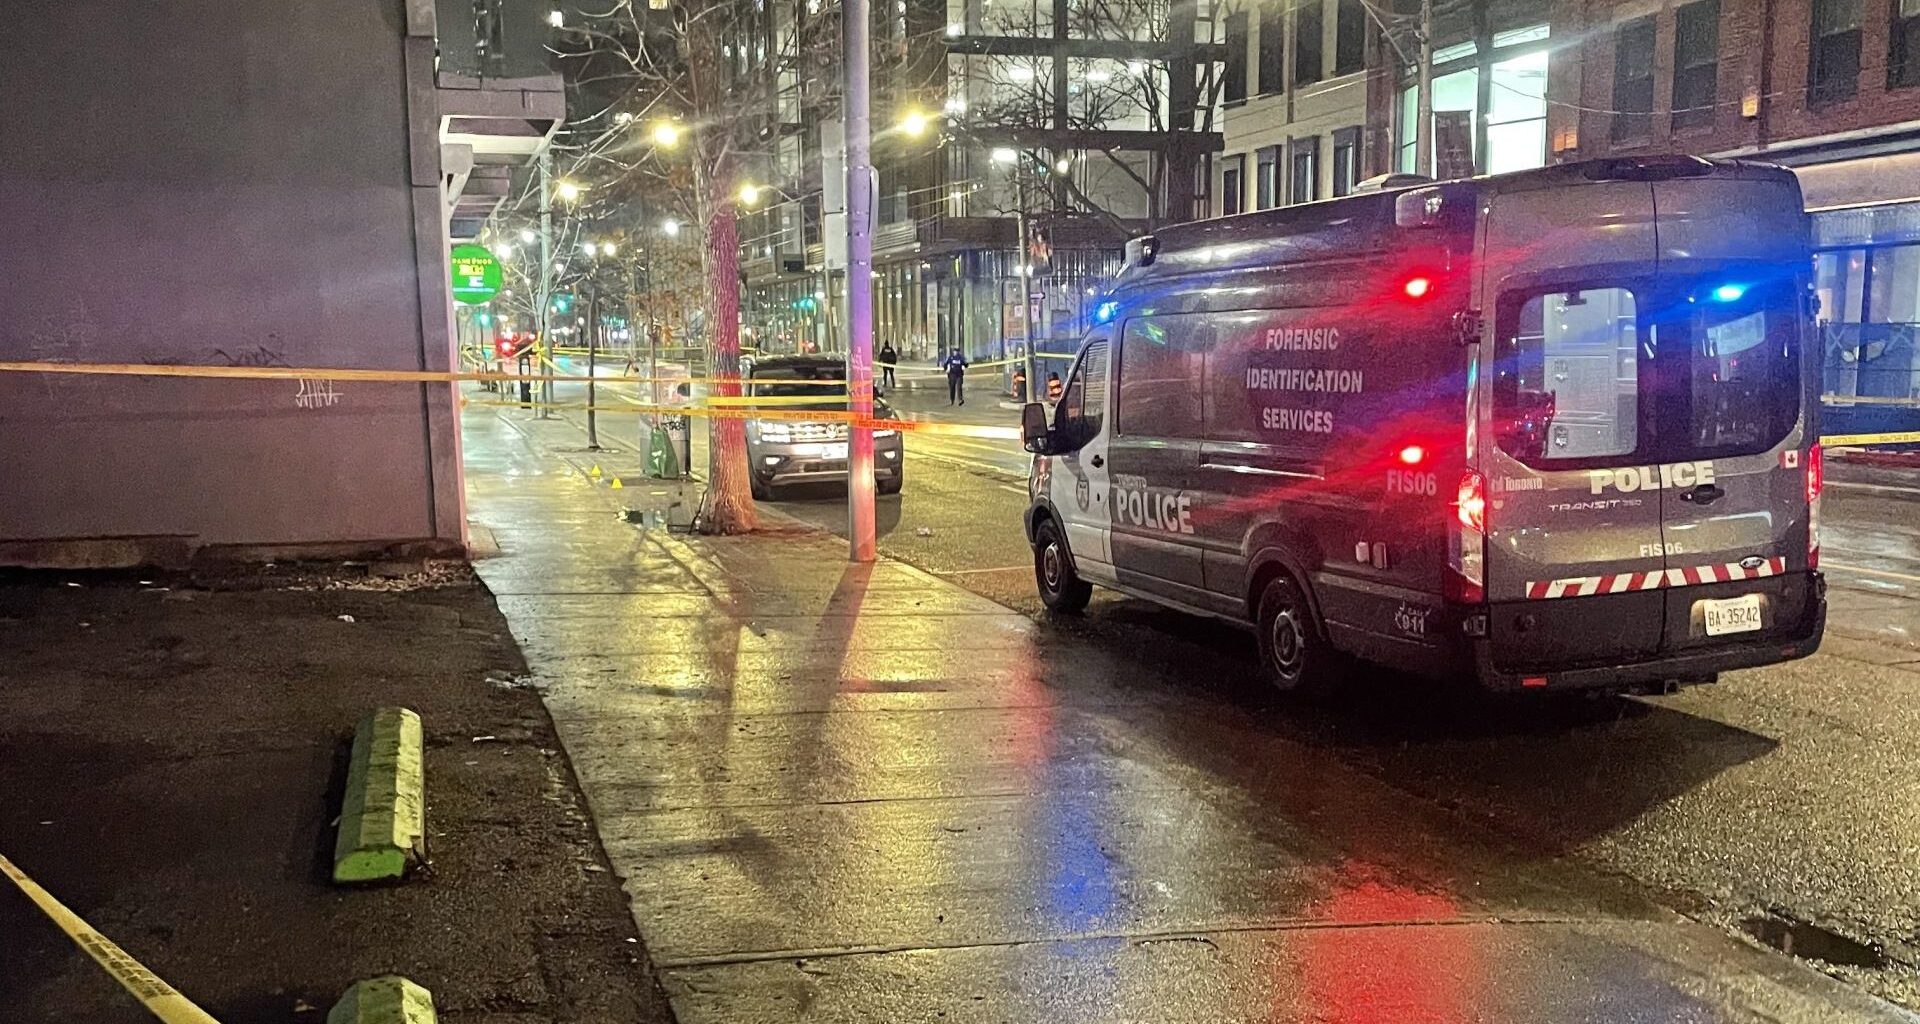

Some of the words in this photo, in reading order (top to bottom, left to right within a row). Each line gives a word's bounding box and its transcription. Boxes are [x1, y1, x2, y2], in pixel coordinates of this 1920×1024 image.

[1265, 327, 1339, 351] FORENSIC
[1246, 367, 1363, 393] IDENTIFICATION
[1262, 407, 1334, 433] SERVICES
[1386, 469, 1438, 496] FIS06
[1589, 460, 1716, 495] POLICE
[1112, 485, 1195, 534] POLICE
[1548, 499, 1620, 512] TRANSIT
[1640, 542, 1684, 558] FIS06
[1402, 614, 1425, 633] 911
